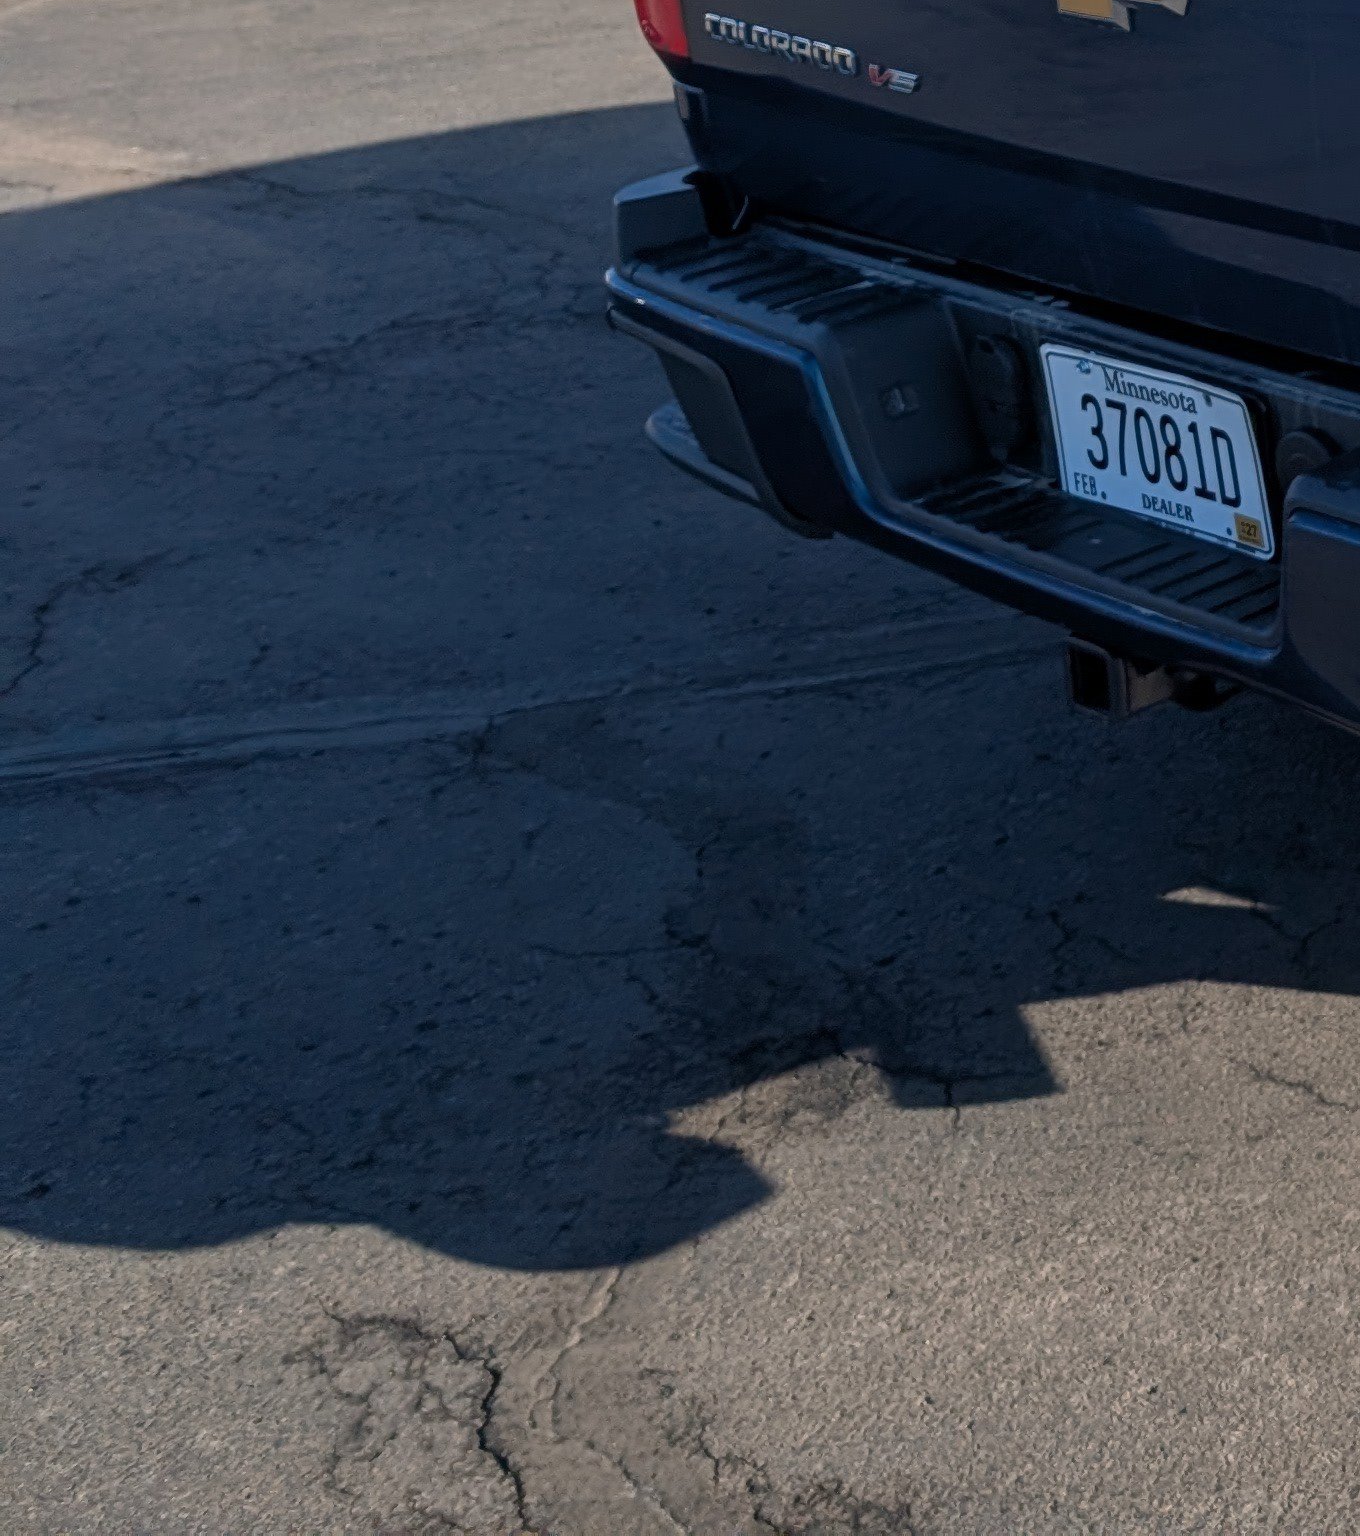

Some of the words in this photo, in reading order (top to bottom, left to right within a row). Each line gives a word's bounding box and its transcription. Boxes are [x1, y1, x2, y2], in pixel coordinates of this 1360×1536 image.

[704, 12, 857, 76] COLORADO
[1102, 366, 1198, 414] Minnesota
[1081, 393, 1242, 509] 37081D
[1073, 471, 1098, 497] FEB
[1141, 492, 1195, 523] DEALER
